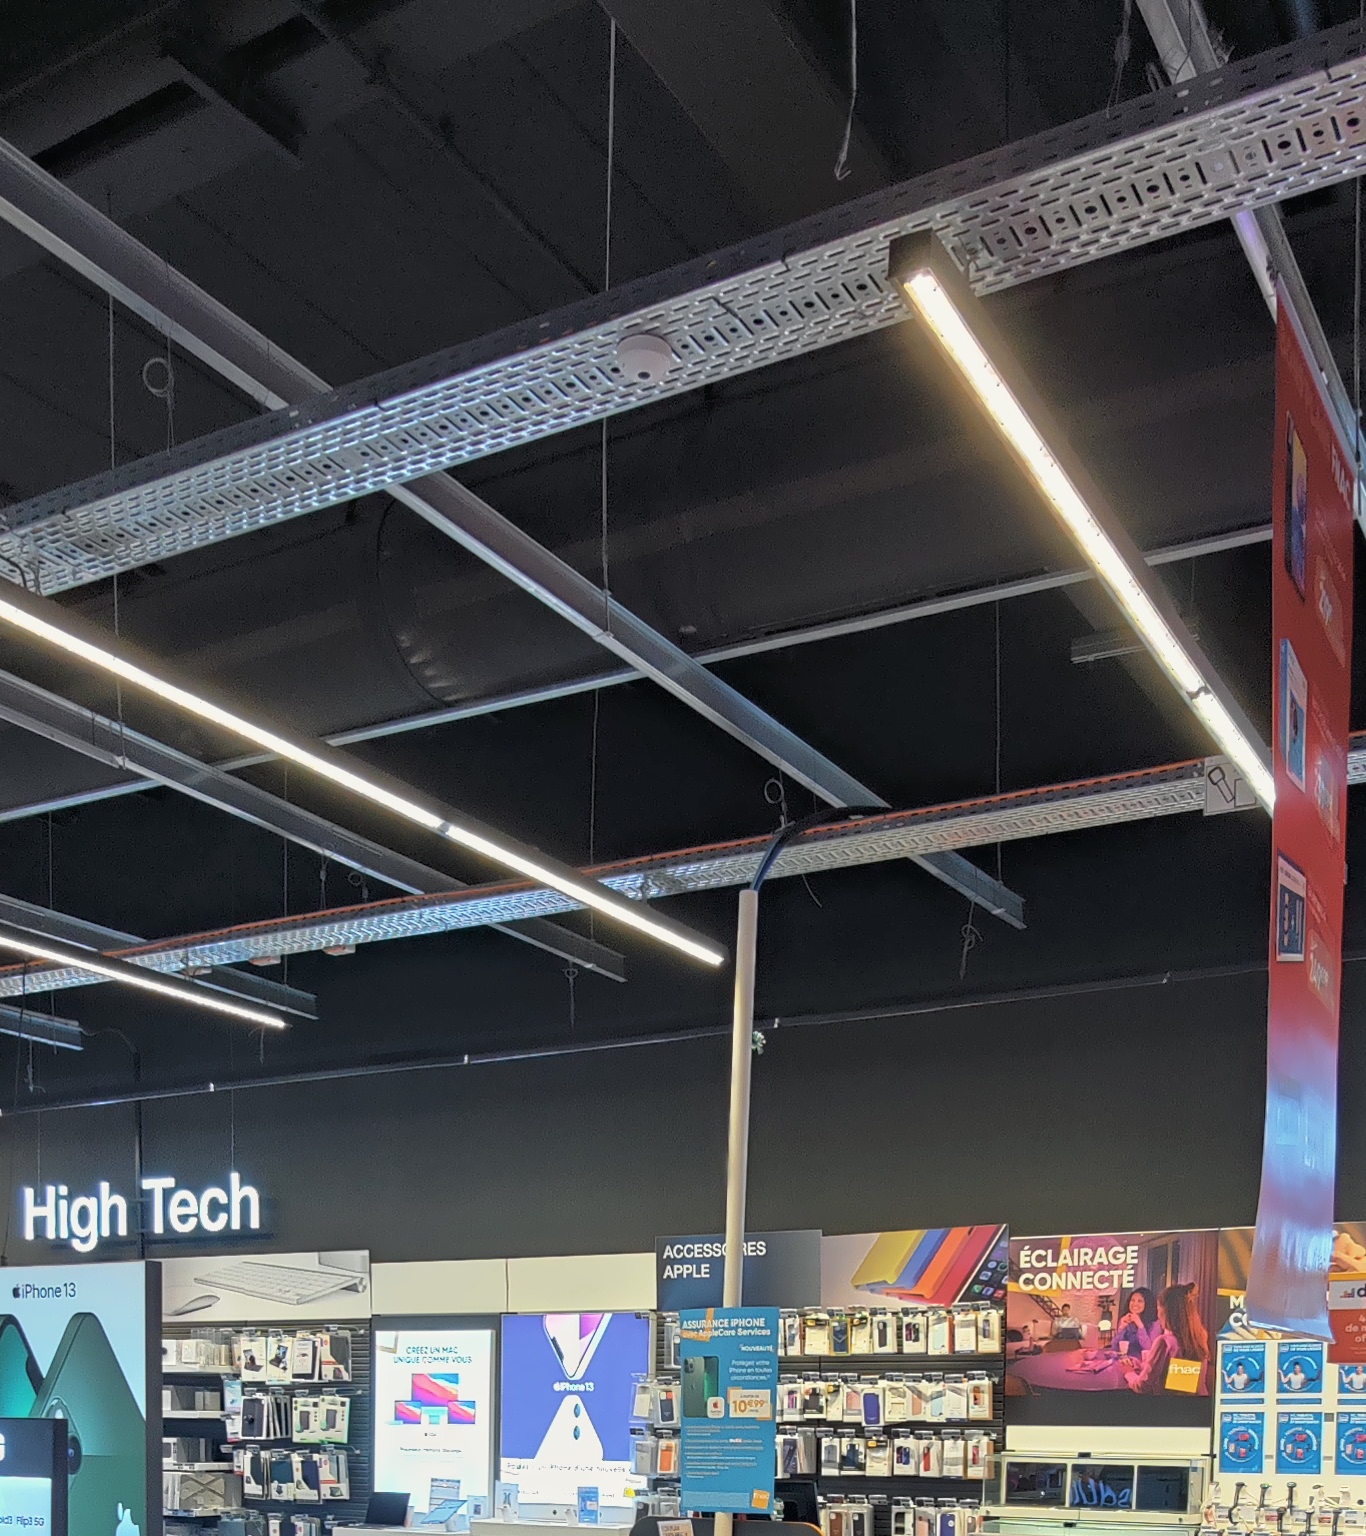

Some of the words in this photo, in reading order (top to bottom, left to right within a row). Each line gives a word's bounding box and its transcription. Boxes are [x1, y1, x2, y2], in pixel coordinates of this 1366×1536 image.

[24, 1181, 127, 1251] High
[142, 1172, 260, 1235] Tech
[663, 1241, 766, 1259] ACCESSES
[1019, 1242, 1138, 1268] ÉCLAIRAGE
[663, 1264, 710, 1279] APPLE
[1019, 1267, 1135, 1291] CONNECTÉ
[21, 1283, 60, 1300] iPhone
[62, 1283, 76, 1298] 13
[682, 1319, 730, 1330] ASSURANCE
[1358, 1314, 1366, 1323] 4
[699, 1328, 735, 1338] AppleCare
[737, 1328, 771, 1336] Services
[1345, 1323, 1359, 1332] de
[1169, 1364, 1201, 1375] fnac
[561, 1382, 584, 1392] iPhone
[585, 1383, 595, 1392] 13
